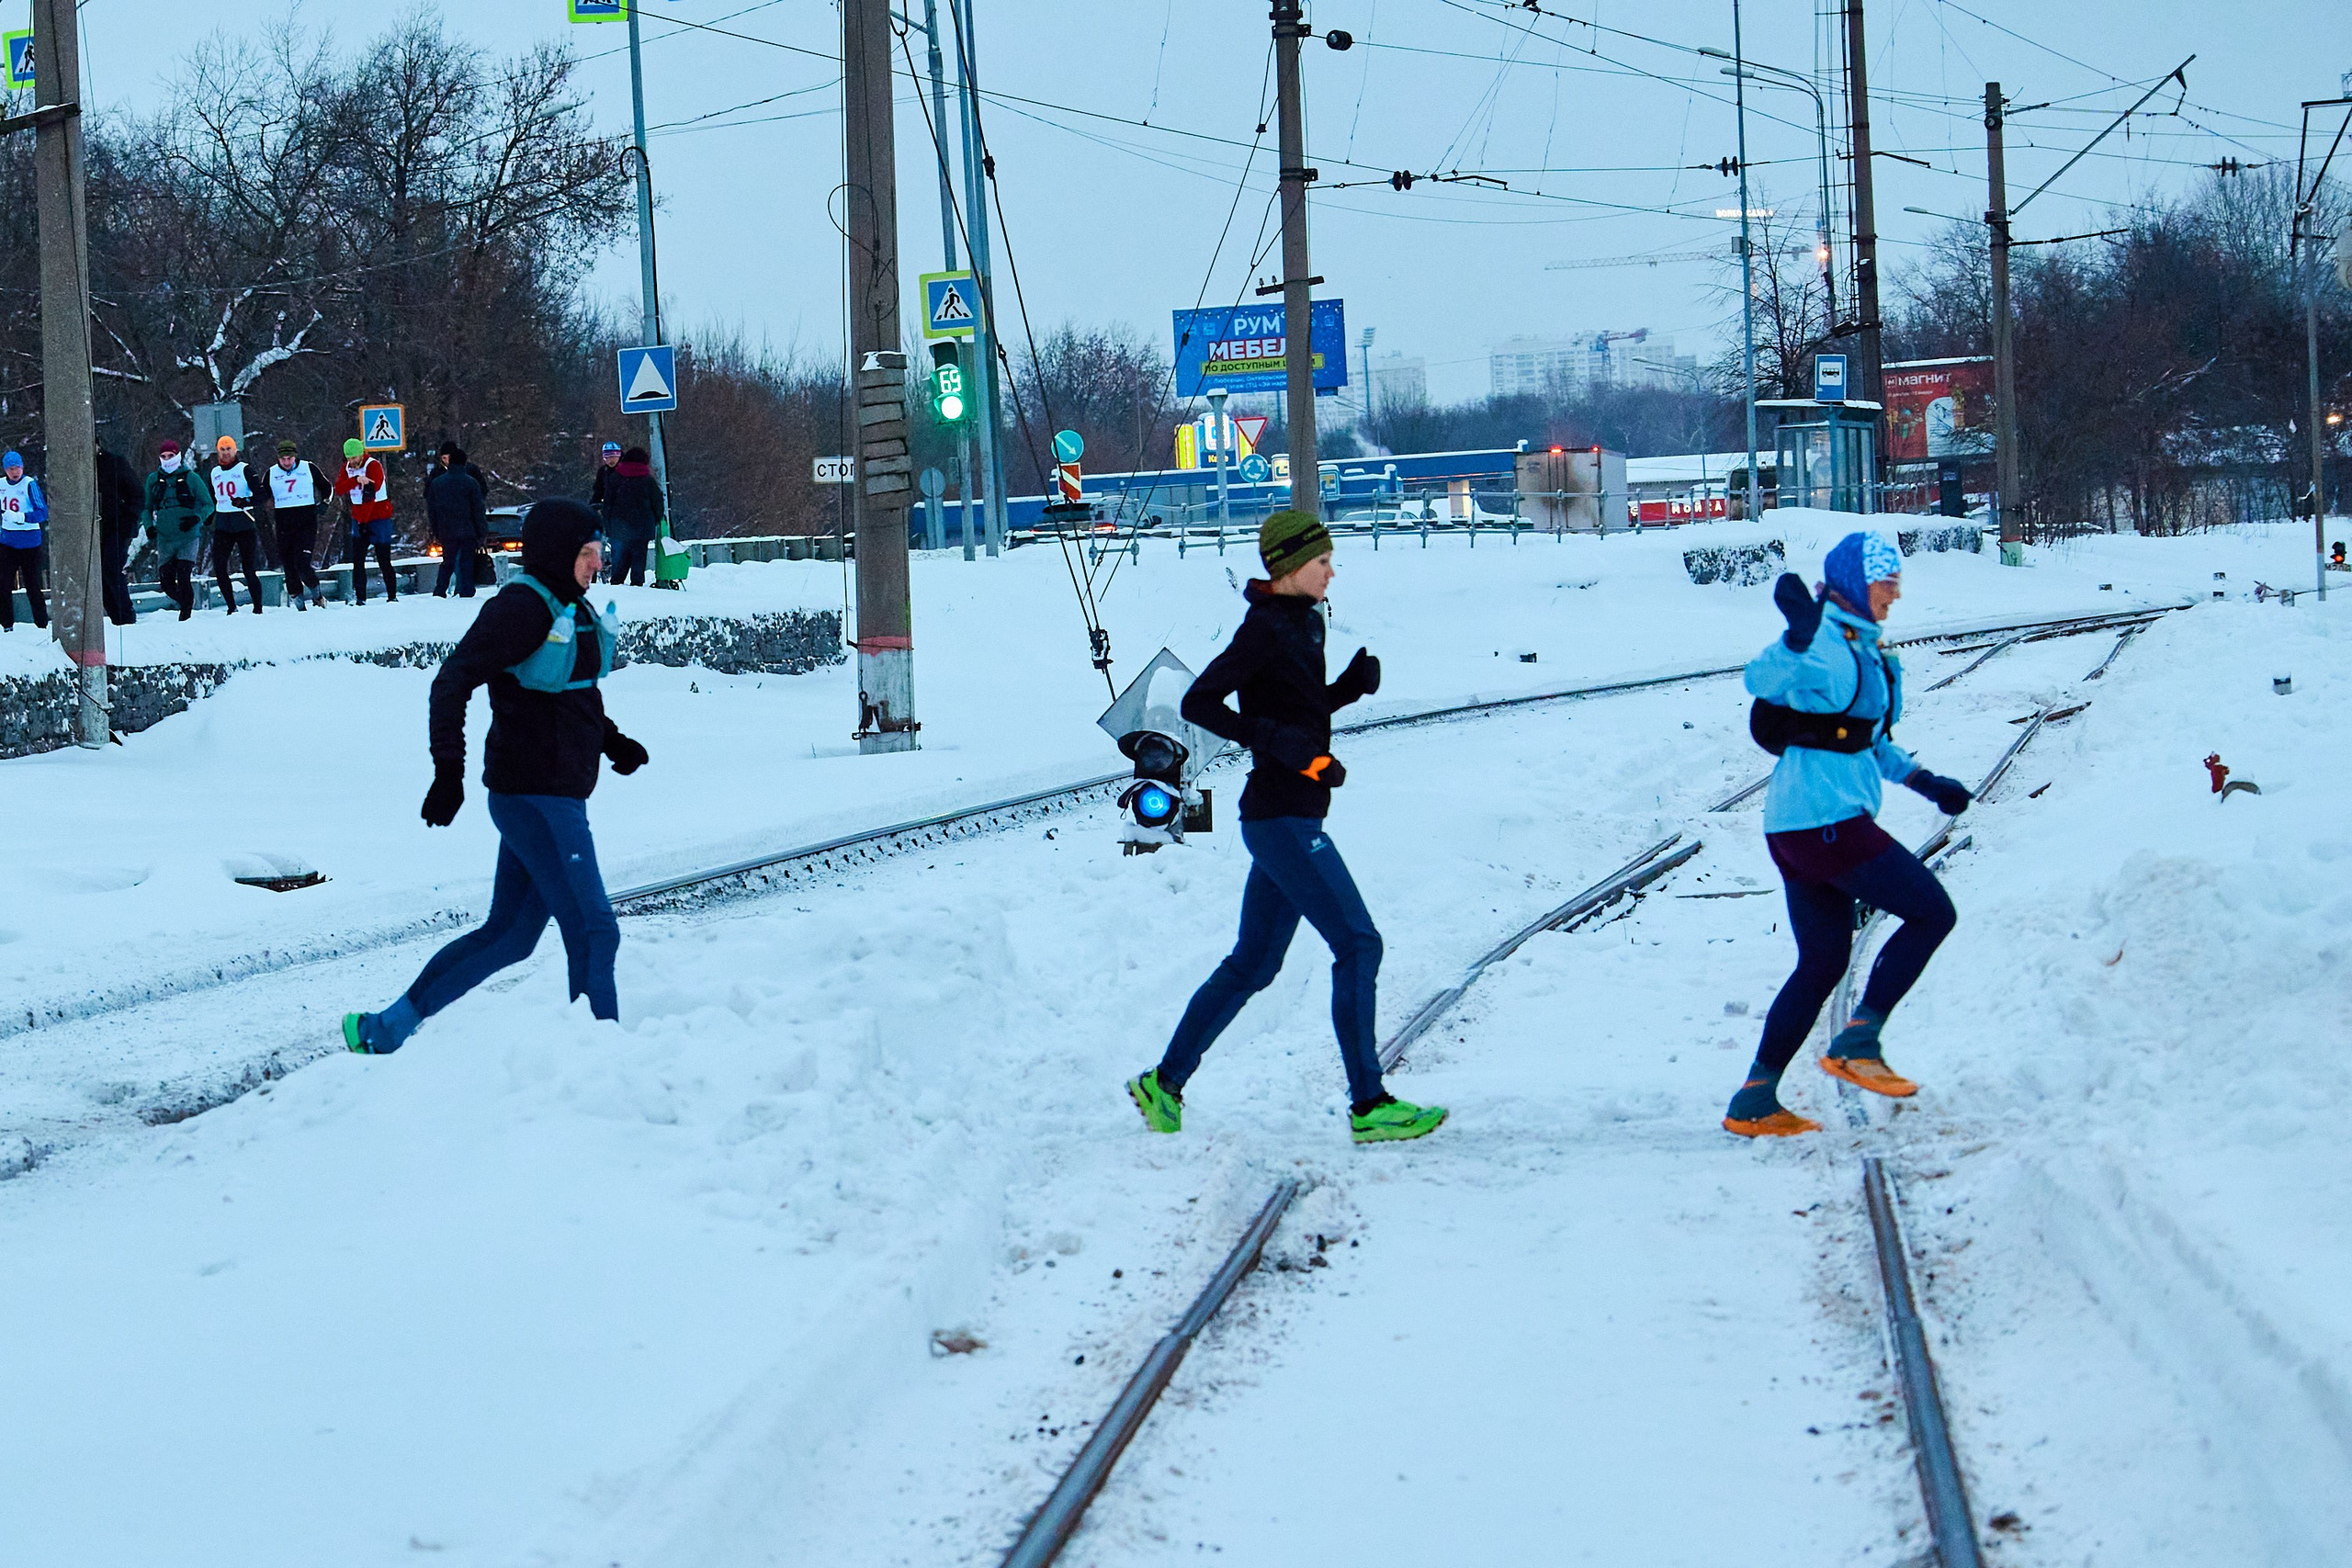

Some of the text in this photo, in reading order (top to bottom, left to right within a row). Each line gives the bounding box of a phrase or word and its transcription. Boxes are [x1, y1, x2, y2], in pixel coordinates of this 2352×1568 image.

[1221, 361, 1280, 372] ДОСТУПНЫМ
[939, 369, 962, 393] 69
[217, 481, 236, 496] 10
[285, 479, 297, 492] 7
[3, 497, 19, 512] 16
